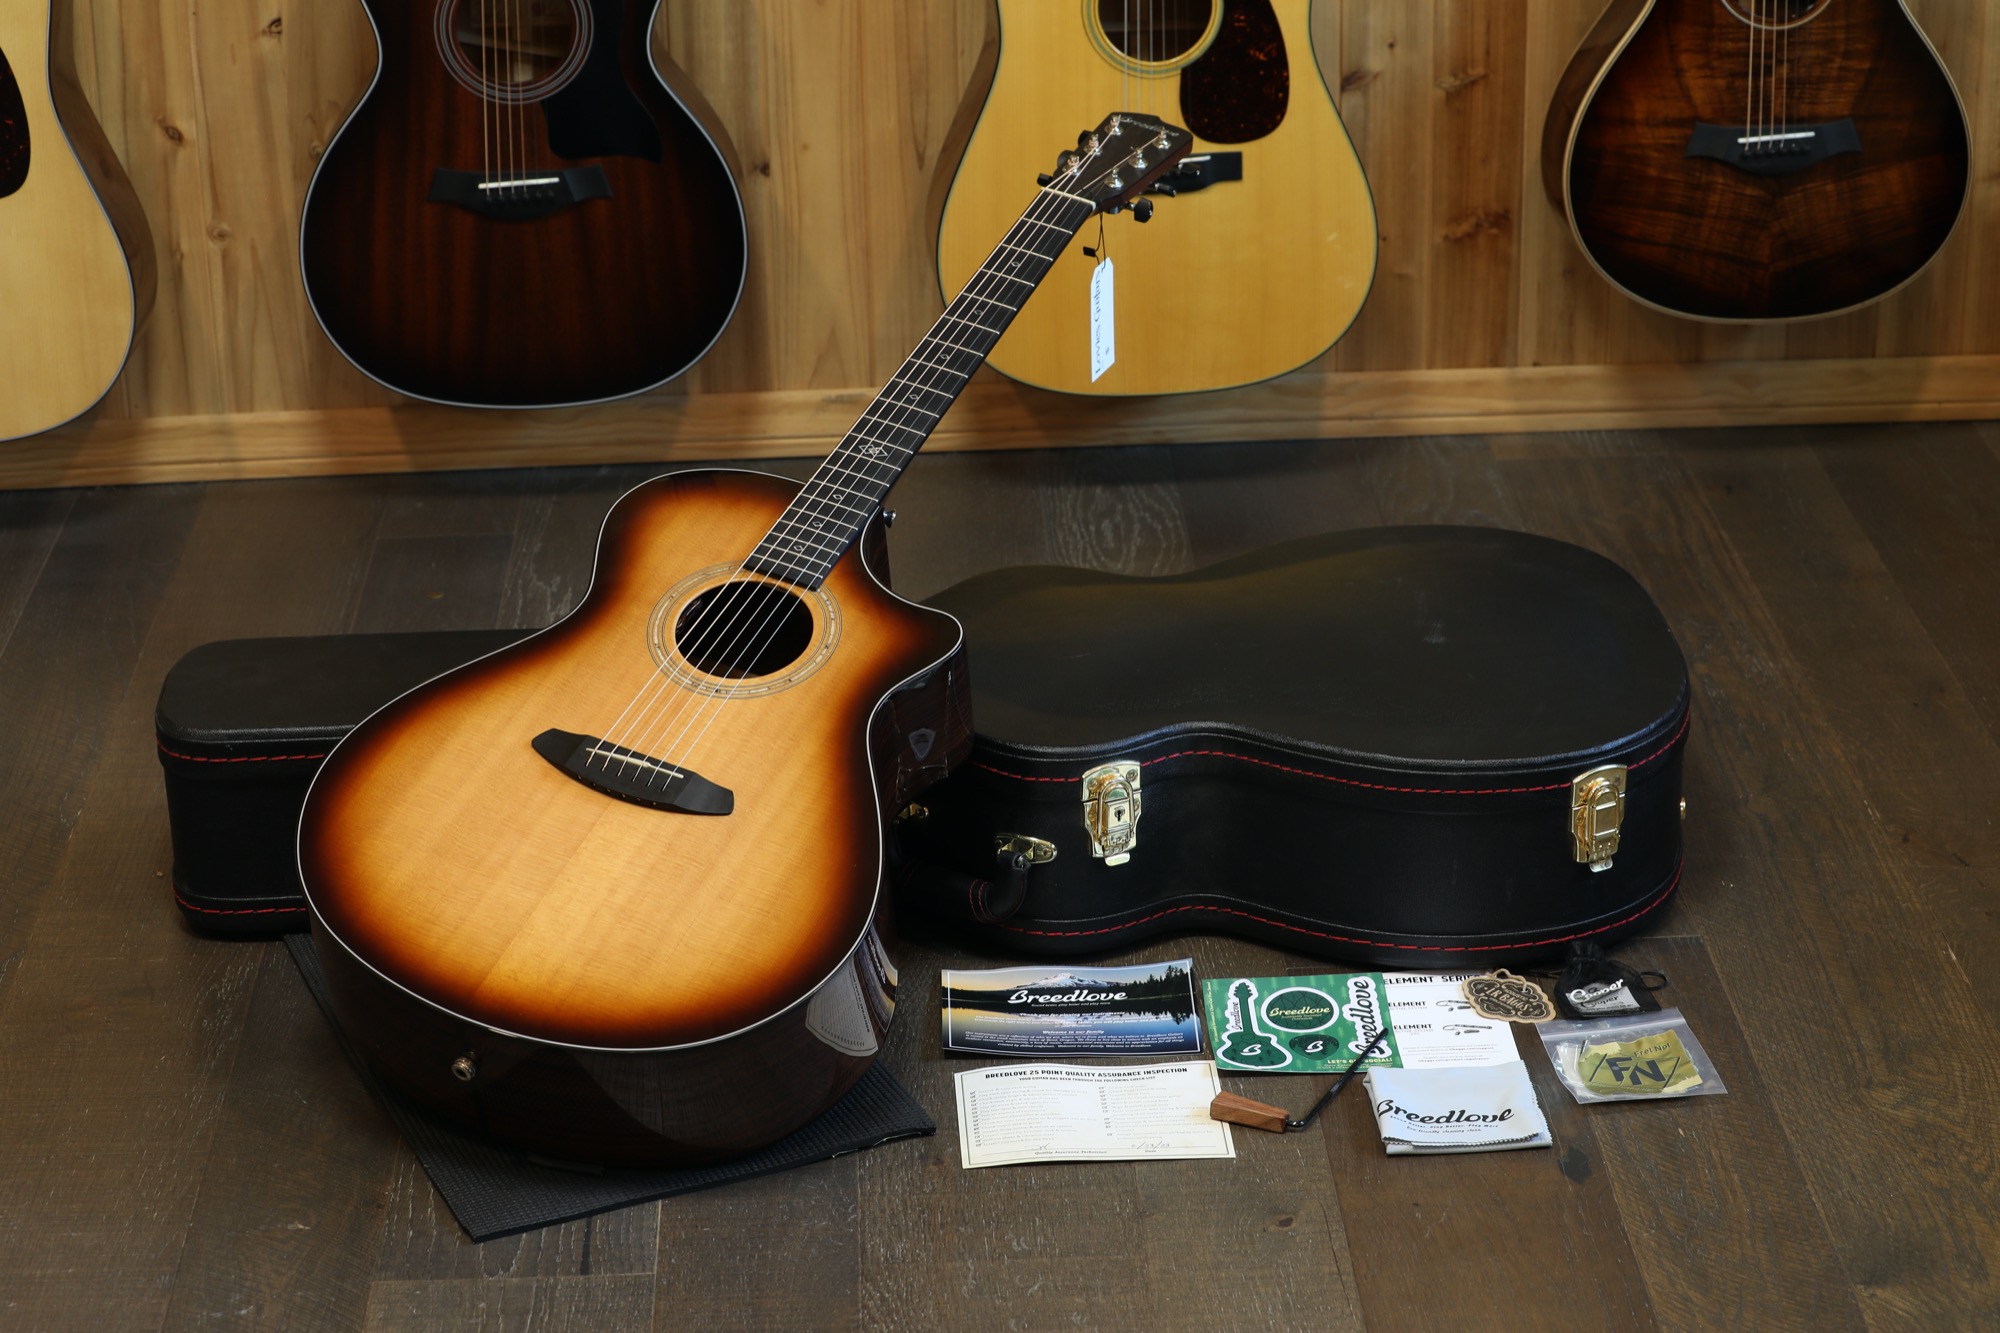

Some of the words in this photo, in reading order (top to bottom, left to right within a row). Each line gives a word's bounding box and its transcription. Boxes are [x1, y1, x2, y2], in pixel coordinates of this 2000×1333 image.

[1384, 976, 1433, 985] ELEMENT
[1441, 974, 1480, 982] SERI
[1007, 989, 1128, 1004] Breedlove
[1500, 993, 1531, 1011] BAGGS
[1230, 1002, 1242, 1030] Breedlove
[1269, 1006, 1330, 1017] Breedlove
[1634, 1046, 1652, 1056] Fret
[1654, 1042, 1670, 1052] Not
[1376, 1100, 1514, 1124] Breedlove
